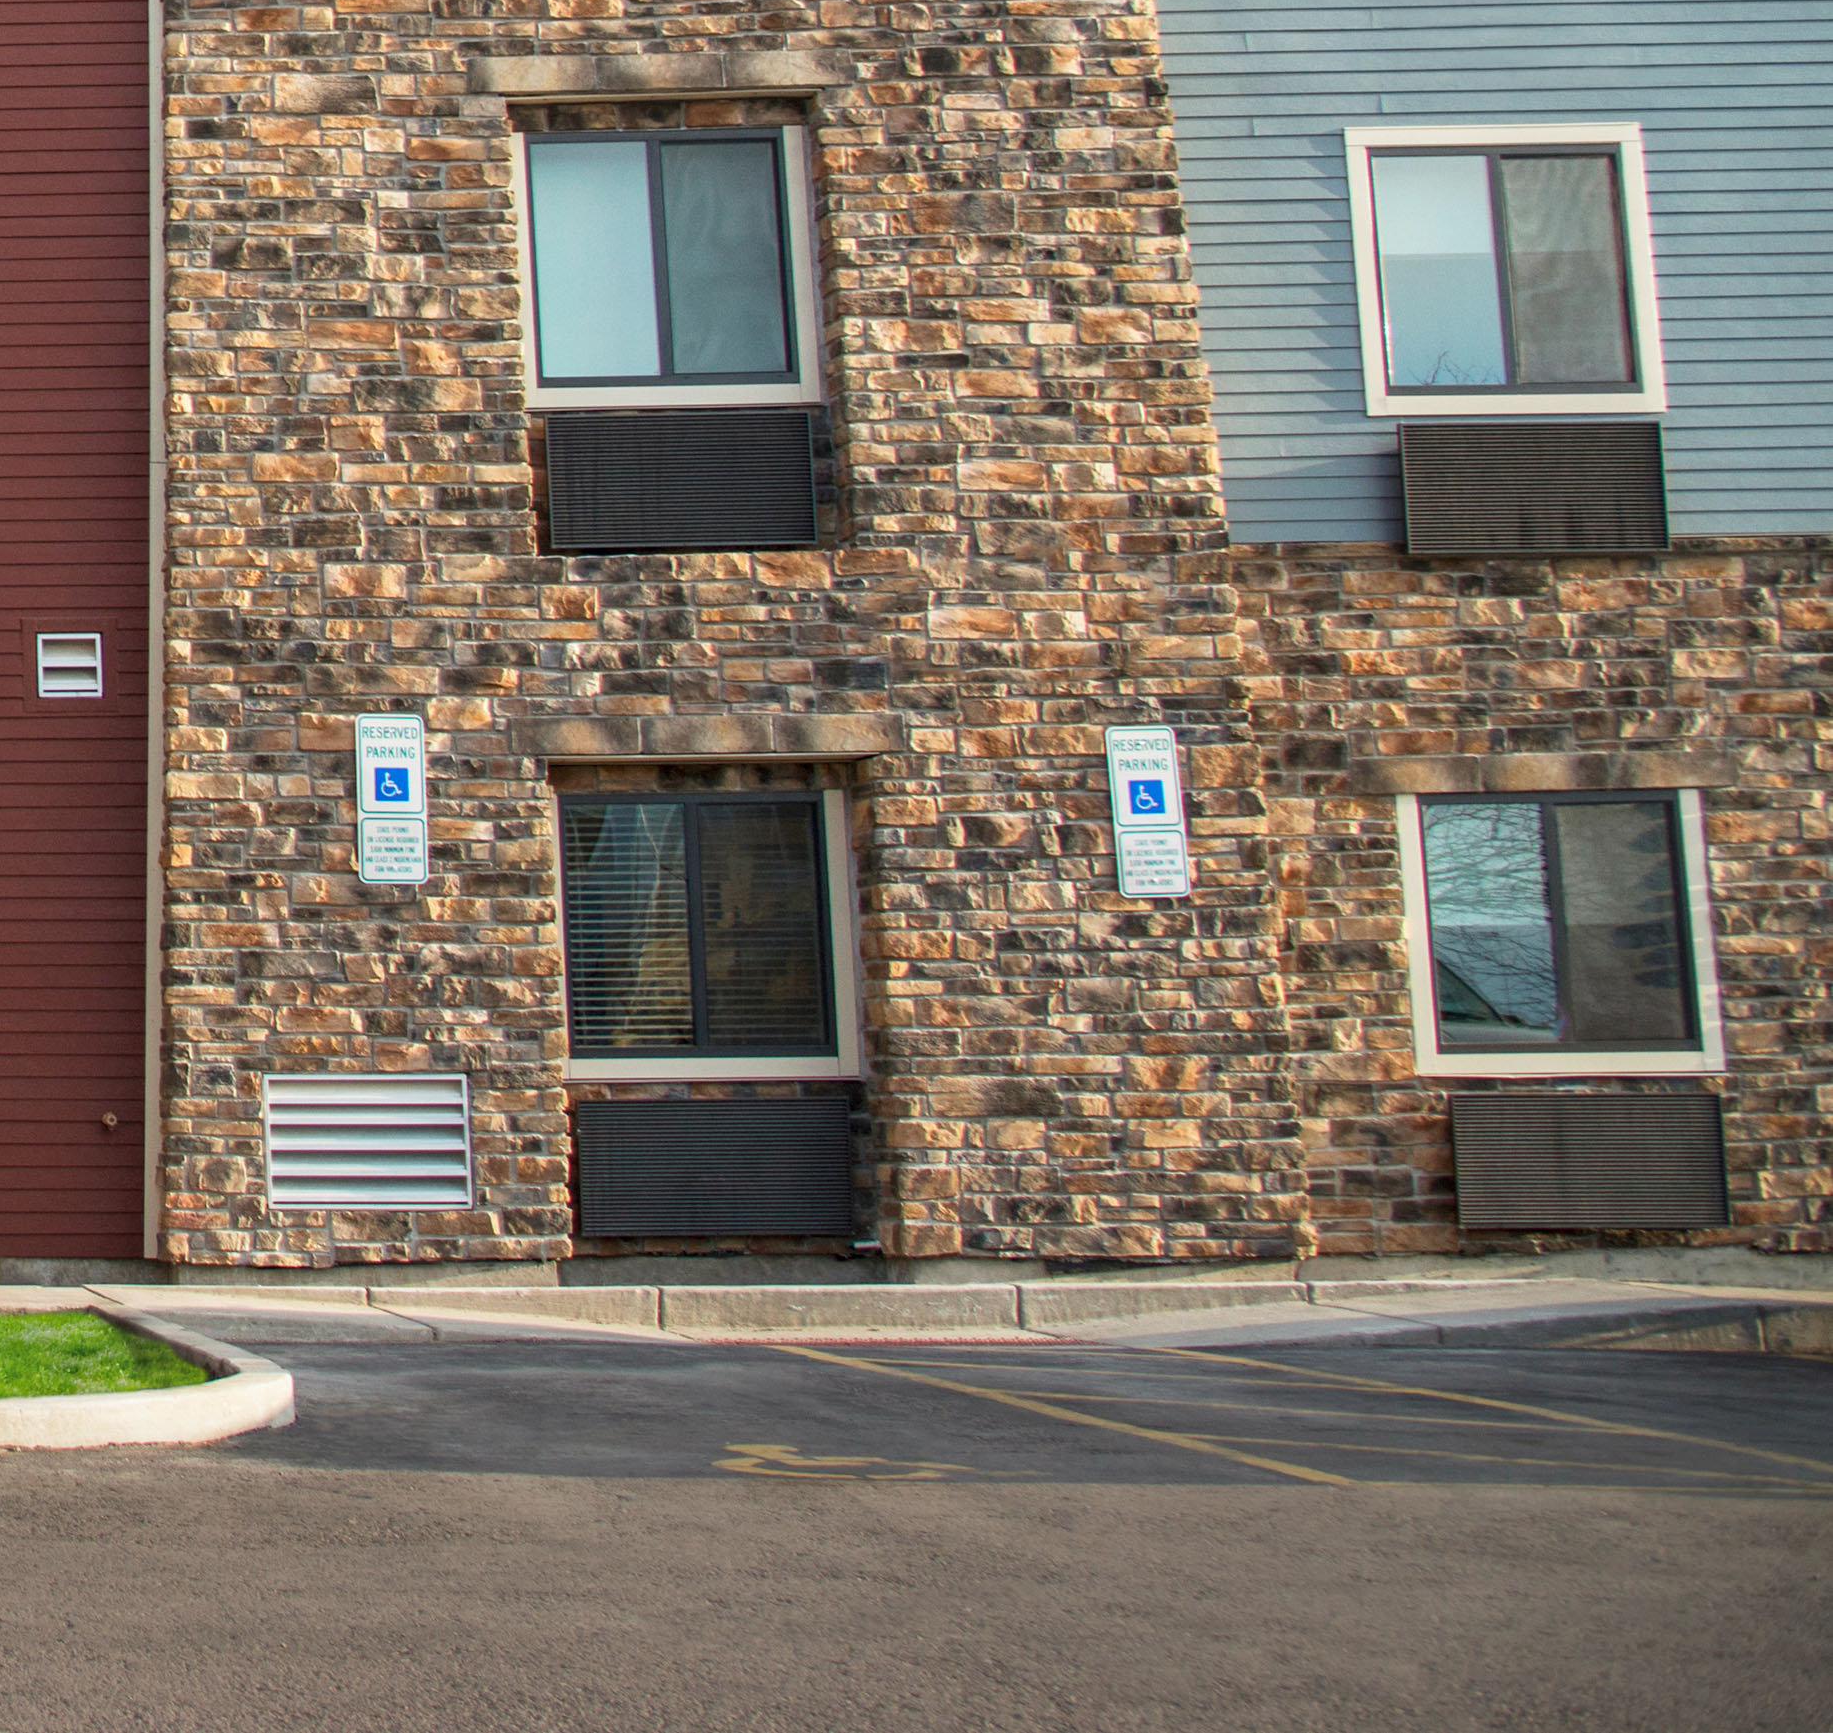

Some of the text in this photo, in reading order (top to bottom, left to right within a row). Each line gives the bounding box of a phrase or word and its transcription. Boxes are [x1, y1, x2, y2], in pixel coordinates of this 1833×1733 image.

[362, 726, 418, 740] RESERVED
[1113, 738, 1169, 752] RESERVED
[366, 746, 415, 759] PARKING
[1118, 758, 1169, 771] PARKING
